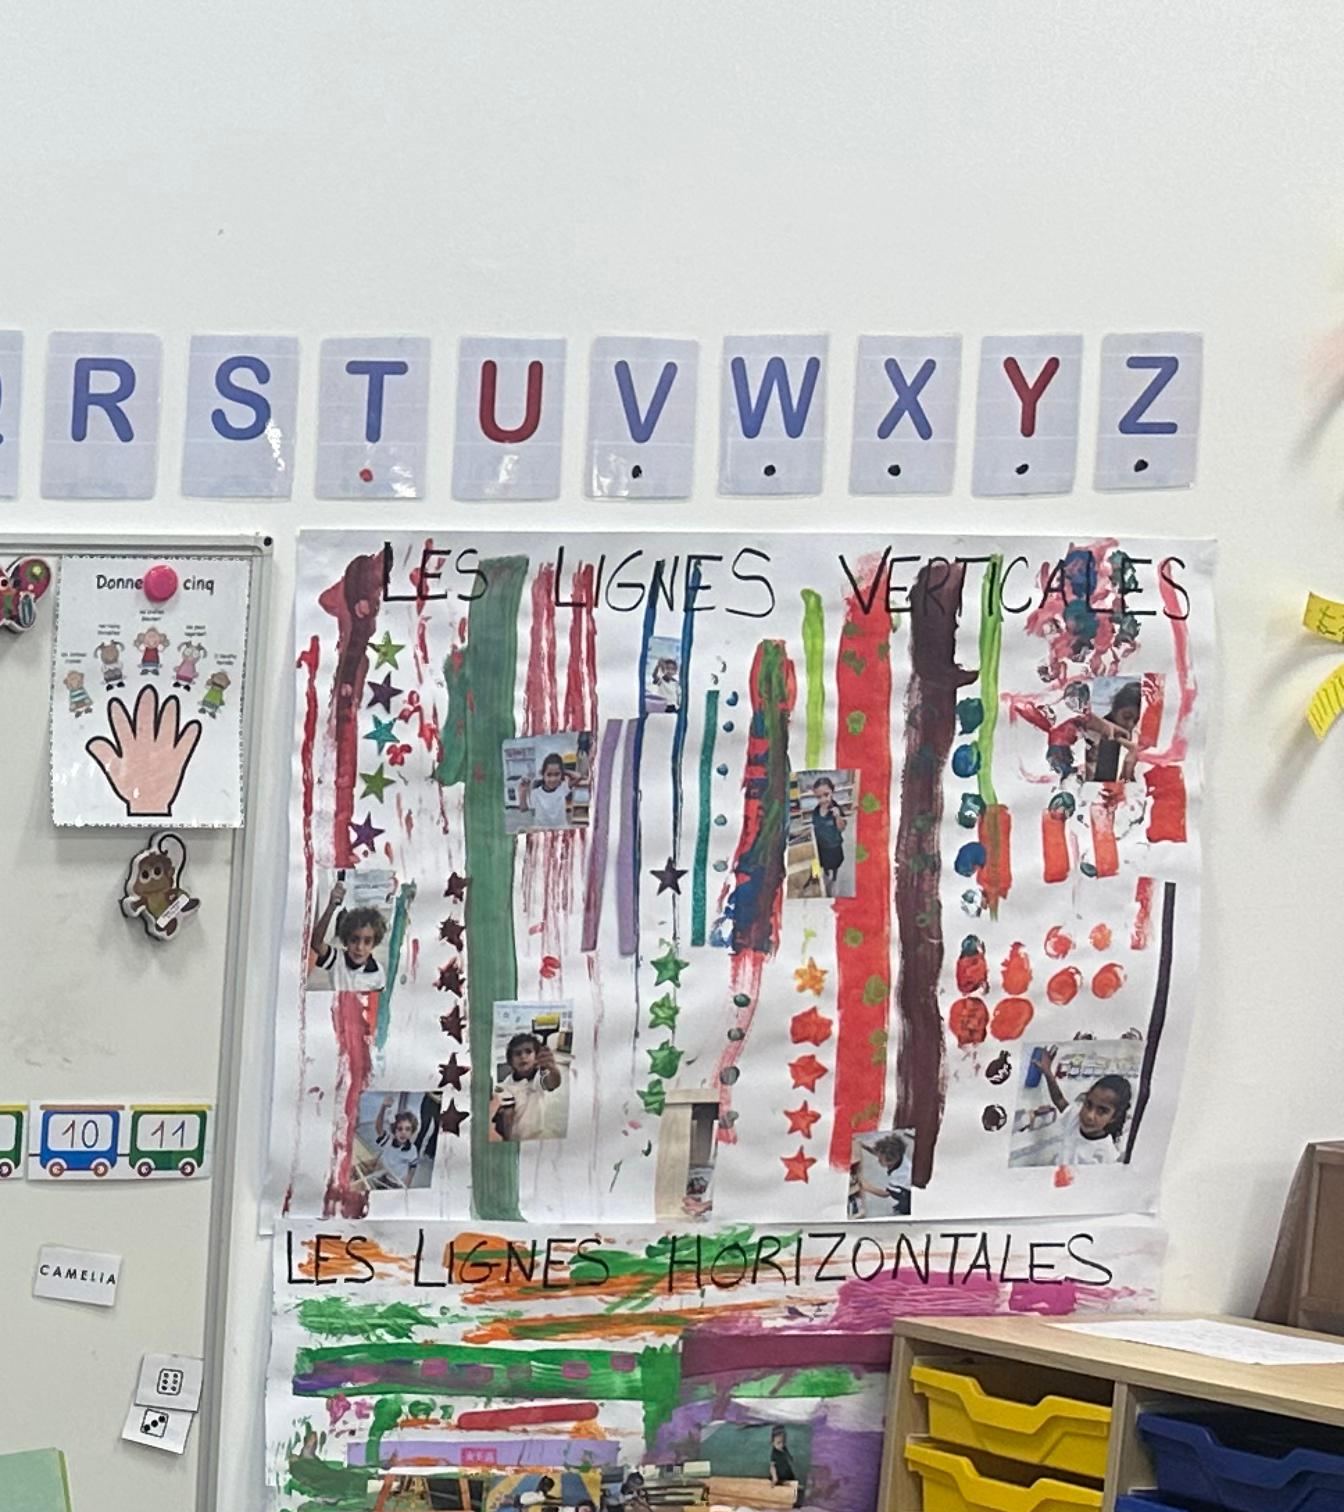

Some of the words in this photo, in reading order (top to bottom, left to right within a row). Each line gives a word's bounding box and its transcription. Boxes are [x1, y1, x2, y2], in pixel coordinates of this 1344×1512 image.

[72, 357, 136, 442] R
[211, 356, 271, 442] S
[345, 360, 408, 443] T
[478, 360, 543, 444] U
[615, 360, 678, 444] V
[731, 356, 820, 440] W
[878, 357, 936, 441] X
[1003, 356, 1060, 438] Y
[1119, 356, 1180, 435] Z
[183, 575, 215, 595] cinq
[385, 540, 488, 602] LES
[554, 546, 775, 618] LIGNES
[839, 545, 1191, 620] VERTICALES
[62, 1117, 100, 1148] 10
[149, 1117, 188, 1148] 11
[39, 1264, 116, 1286] CAMELIA
[284, 1228, 375, 1286] LES
[413, 1227, 611, 1288] LIGNES
[668, 1228, 1113, 1294] HORIZONTALES
